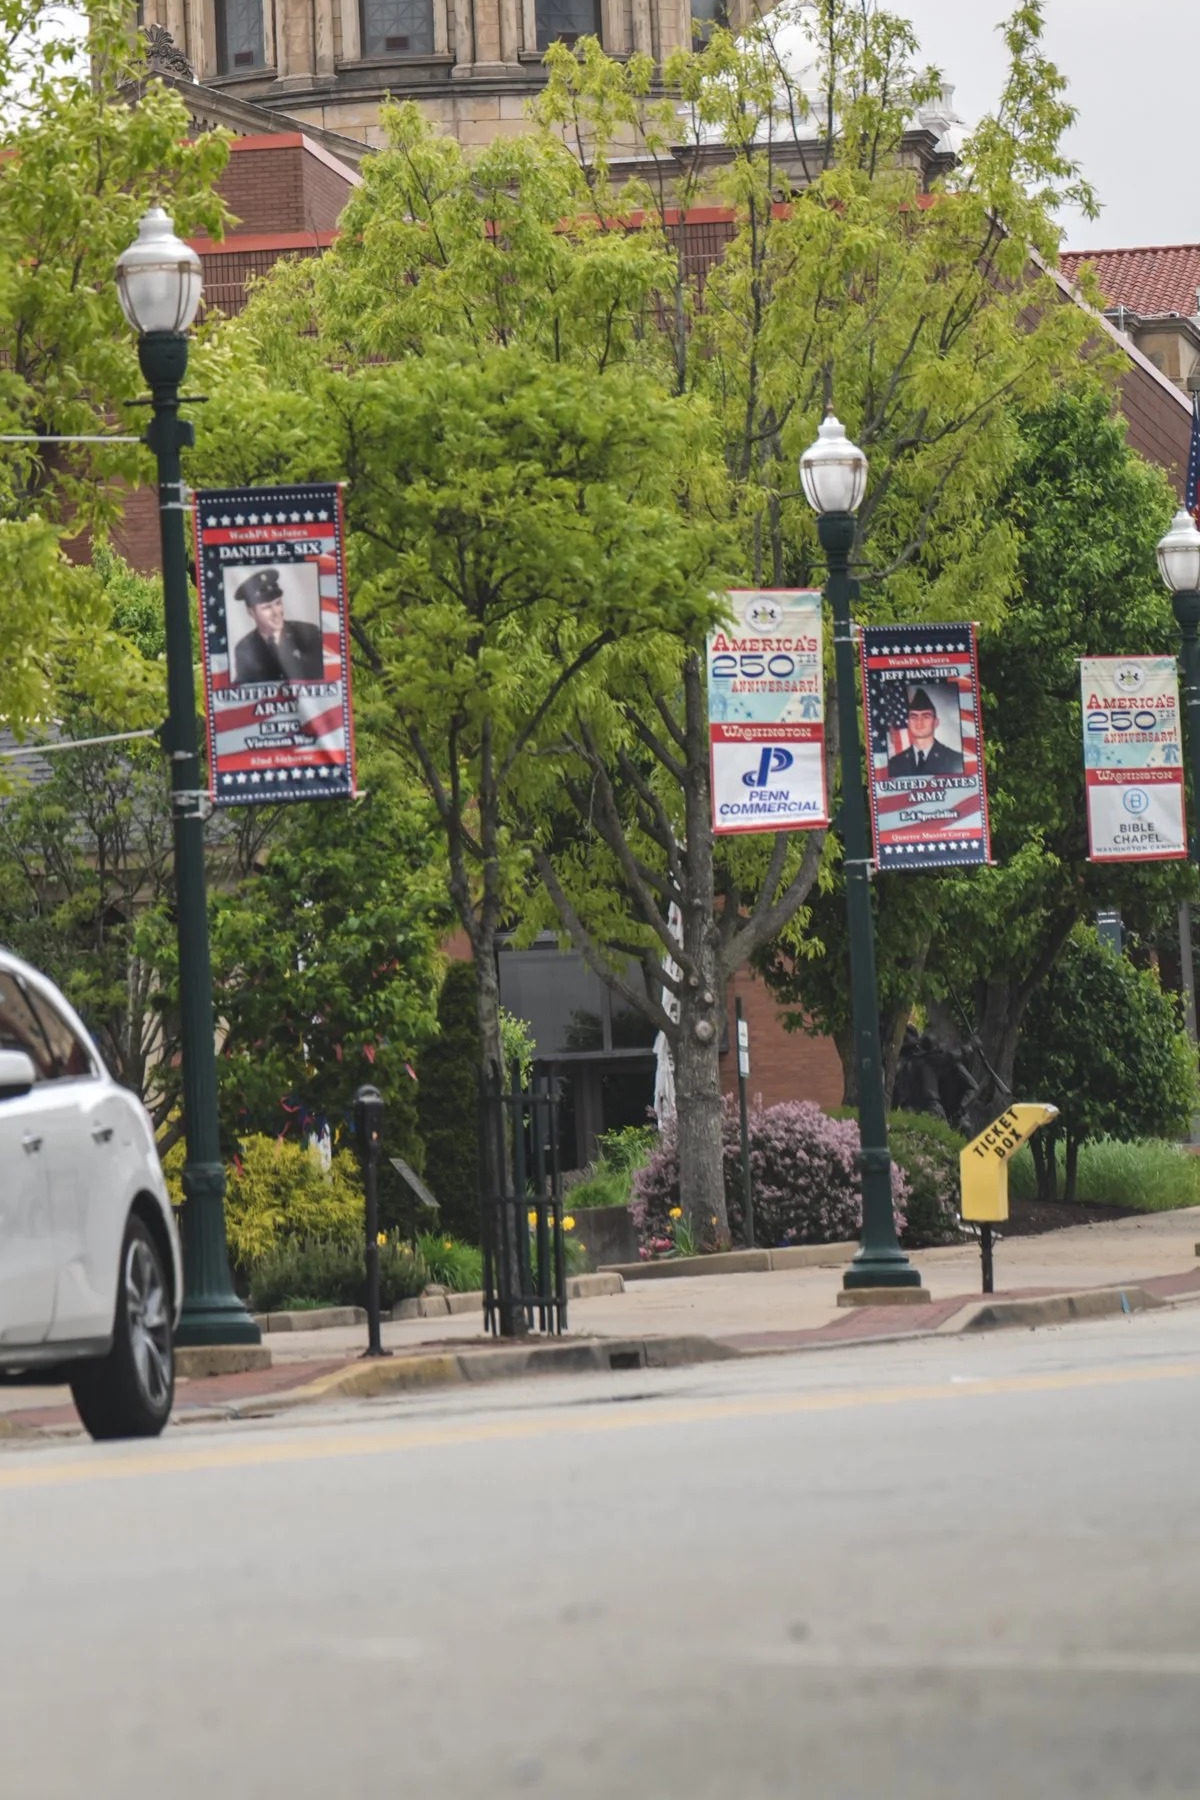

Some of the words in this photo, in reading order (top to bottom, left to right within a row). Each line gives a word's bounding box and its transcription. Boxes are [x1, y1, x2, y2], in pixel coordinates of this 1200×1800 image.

[219, 545, 274, 559] DANIEL
[276, 543, 290, 556] E.
[294, 542, 320, 555] SIX
[712, 633, 817, 652] AMERICA'S
[712, 654, 795, 678] 250
[880, 670, 905, 682] JEFF
[905, 668, 958, 679] HANCHER
[731, 673, 819, 693] ANNIVERSARY!
[218, 686, 278, 700] UNITED
[281, 684, 337, 698] STATES
[254, 701, 298, 716] ARMY
[1087, 694, 1176, 709] AMERICA'S
[277, 722, 300, 733] PFC
[1087, 711, 1157, 731] 250
[246, 737, 292, 749] Vietnam
[293, 735, 313, 746] War
[1103, 726, 1178, 744] ANNIVERSARY!
[880, 779, 927, 791] UNITED
[930, 778, 976, 788] STATES
[749, 790, 790, 801] PENN
[909, 791, 945, 802] ARMY
[719, 801, 820, 816] COMMERCIAL
[917, 811, 958, 822] Specialist
[1119, 822, 1155, 833] BIBLE
[1113, 833, 1163, 845] CHAPEL
[972, 1109, 1019, 1158] TICKET
[993, 1128, 1023, 1159] BOX
